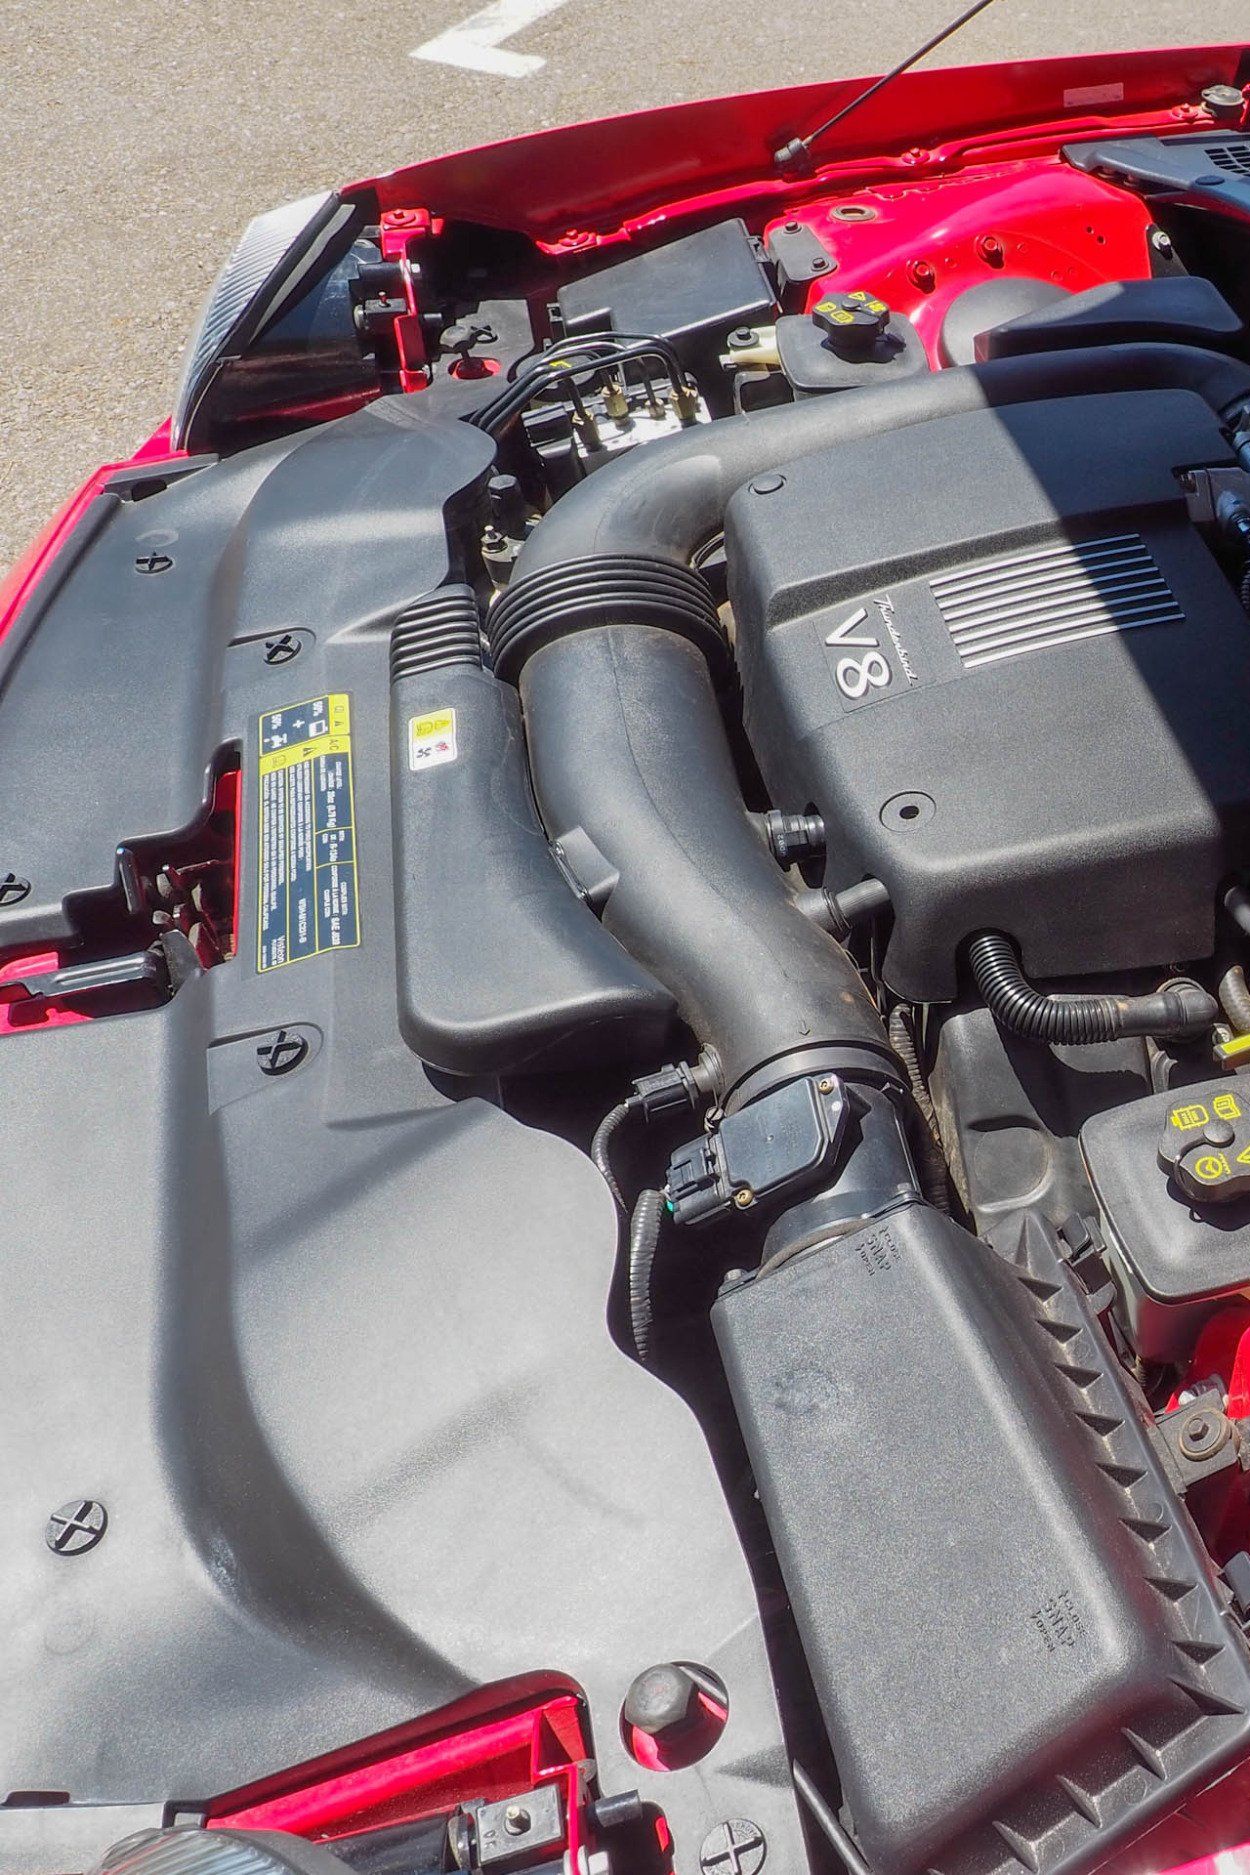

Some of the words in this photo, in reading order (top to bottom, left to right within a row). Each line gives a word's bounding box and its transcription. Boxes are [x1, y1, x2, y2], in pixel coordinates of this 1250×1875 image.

[825, 608, 892, 700] V8
[873, 594, 918, 687] Thunderbird
[867, 1234, 891, 1270] SNAP
[1045, 1599, 1075, 1646] SNAP
